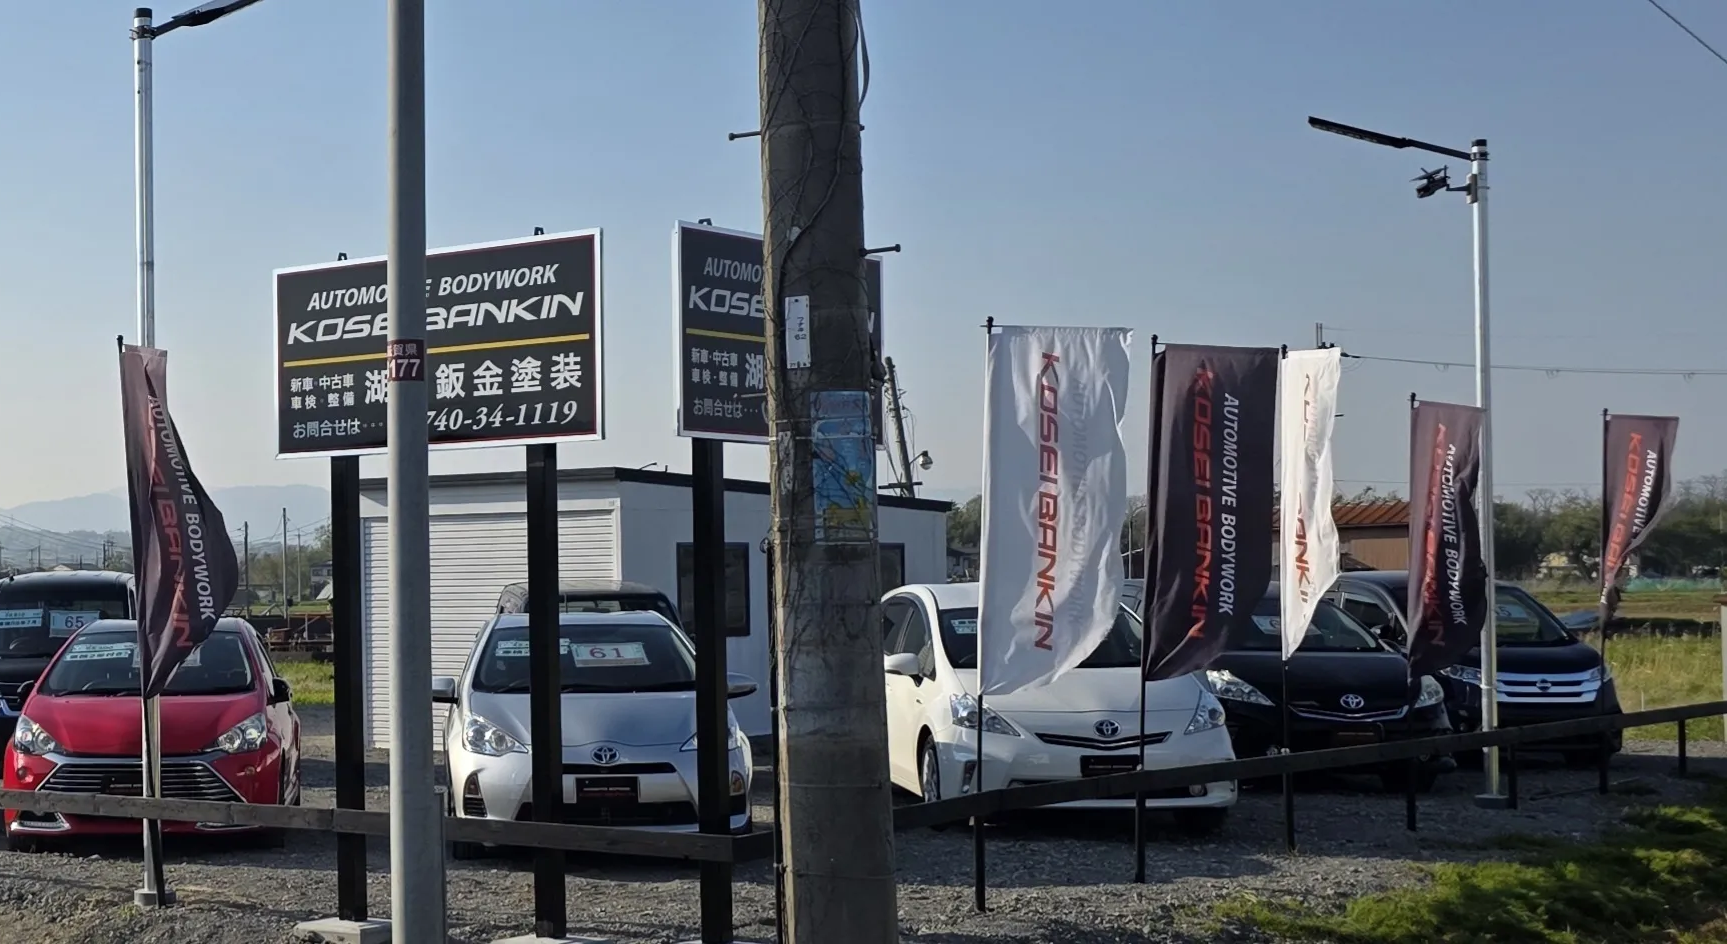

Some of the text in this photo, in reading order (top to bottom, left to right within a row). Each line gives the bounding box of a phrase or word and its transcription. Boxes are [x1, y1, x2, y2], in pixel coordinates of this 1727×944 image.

[438, 264, 560, 296] BODYWORK
[704, 257, 764, 283] AUTOMO
[287, 292, 584, 345] KOSE BANKIN
[689, 285, 764, 318] KOSE
[794, 333, 807, 341] 62
[364, 352, 582, 404] 湖鈑金塗装
[387, 358, 421, 378] 177
[427, 400, 577, 431] 740-34-1119
[1034, 352, 1060, 651] KOSEI BANKIN
[1189, 367, 1214, 638] KOSEI BANKIN
[1218, 393, 1240, 616] AUTOMOTIVE BODYWORK
[1632, 449, 1658, 533] AUTOMOTIVE
[186, 513, 216, 620] BODYWORK
[1444, 548, 1467, 625] BODYWORK
[65, 616, 85, 629] 65
[589, 647, 625, 659] 61
